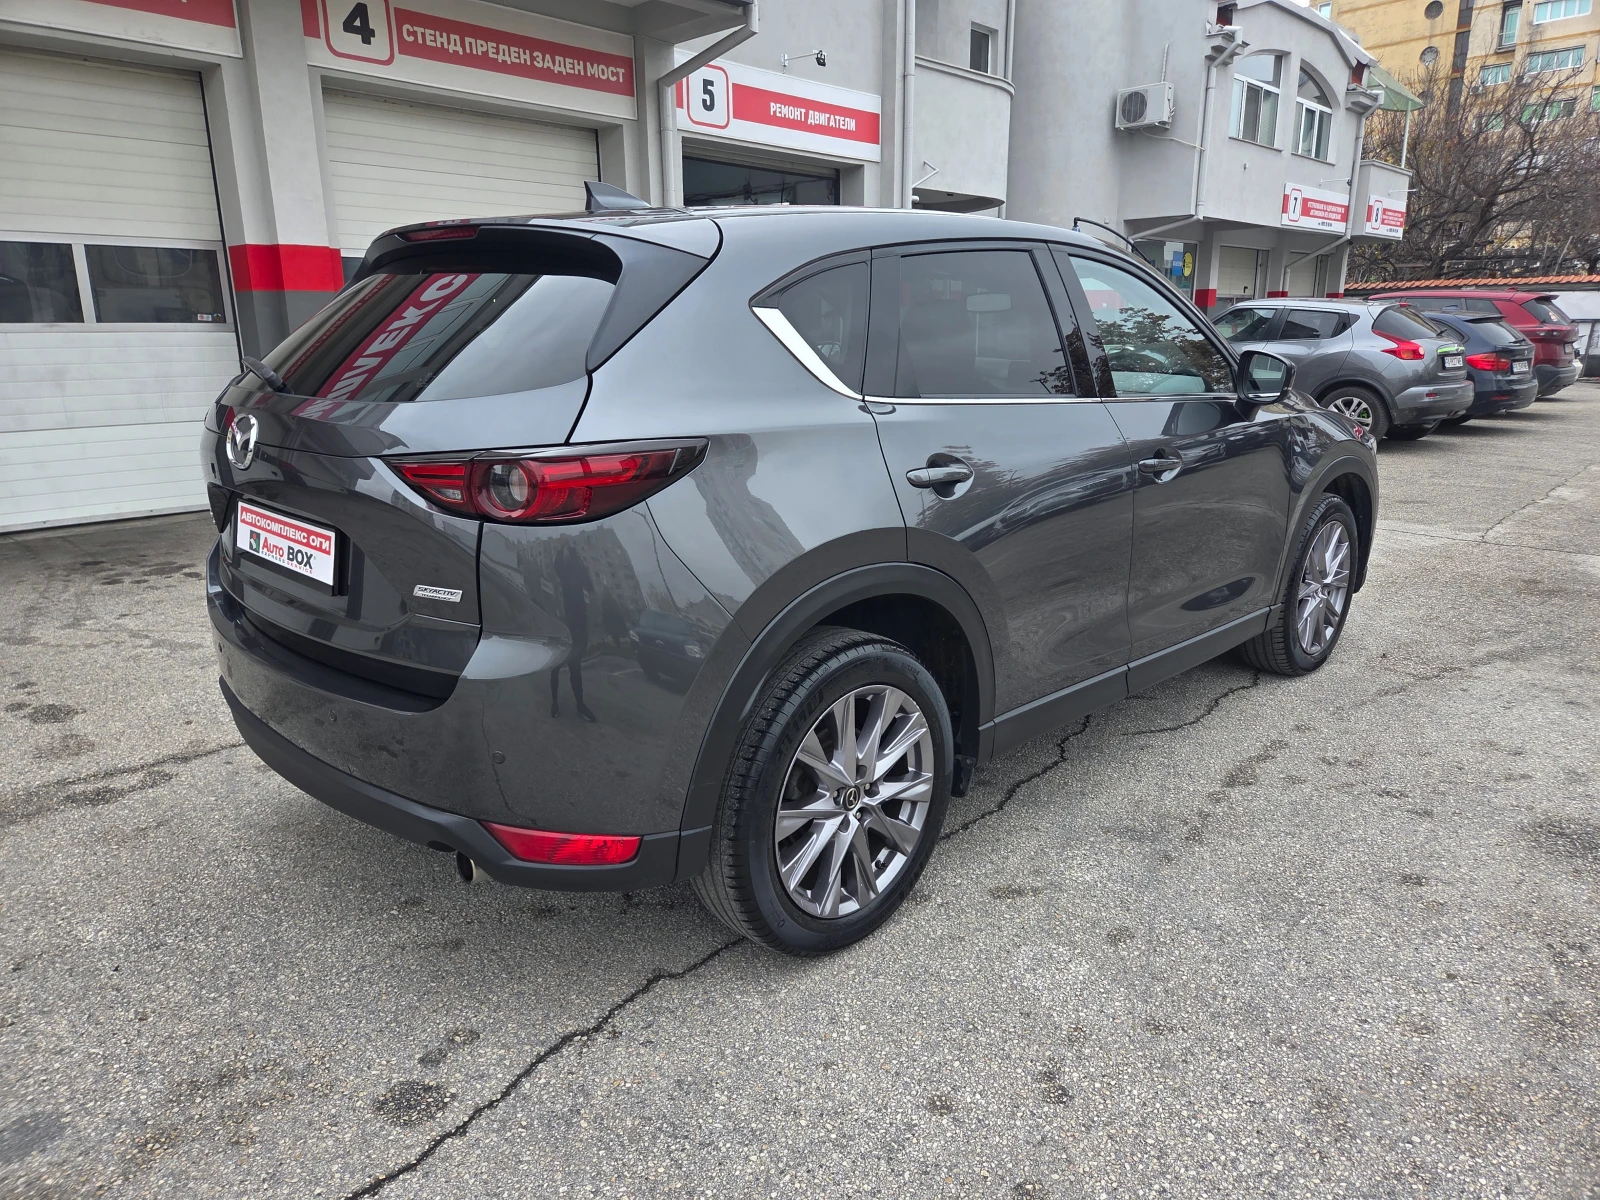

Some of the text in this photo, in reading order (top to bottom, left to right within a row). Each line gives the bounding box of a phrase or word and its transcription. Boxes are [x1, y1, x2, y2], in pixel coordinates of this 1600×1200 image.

[342, 2, 376, 46] 4
[402, 23, 625, 83] СТЕНД ПРЕДЕН ЗАДЕН МОСТ
[701, 78, 715, 112] 5
[770, 102, 856, 132] РЕМОНТ ДВИГАТЕЛИ
[1293, 196, 1298, 214] 7
[1375, 207, 1379, 223] 8
[241, 511, 330, 551] АВТОКОМПЛЕКС ОГИ
[261, 550, 313, 575] EXPRESS SERVICE
[287, 545, 314, 570] BOX
[417, 586, 457, 597] SKYACTIV
